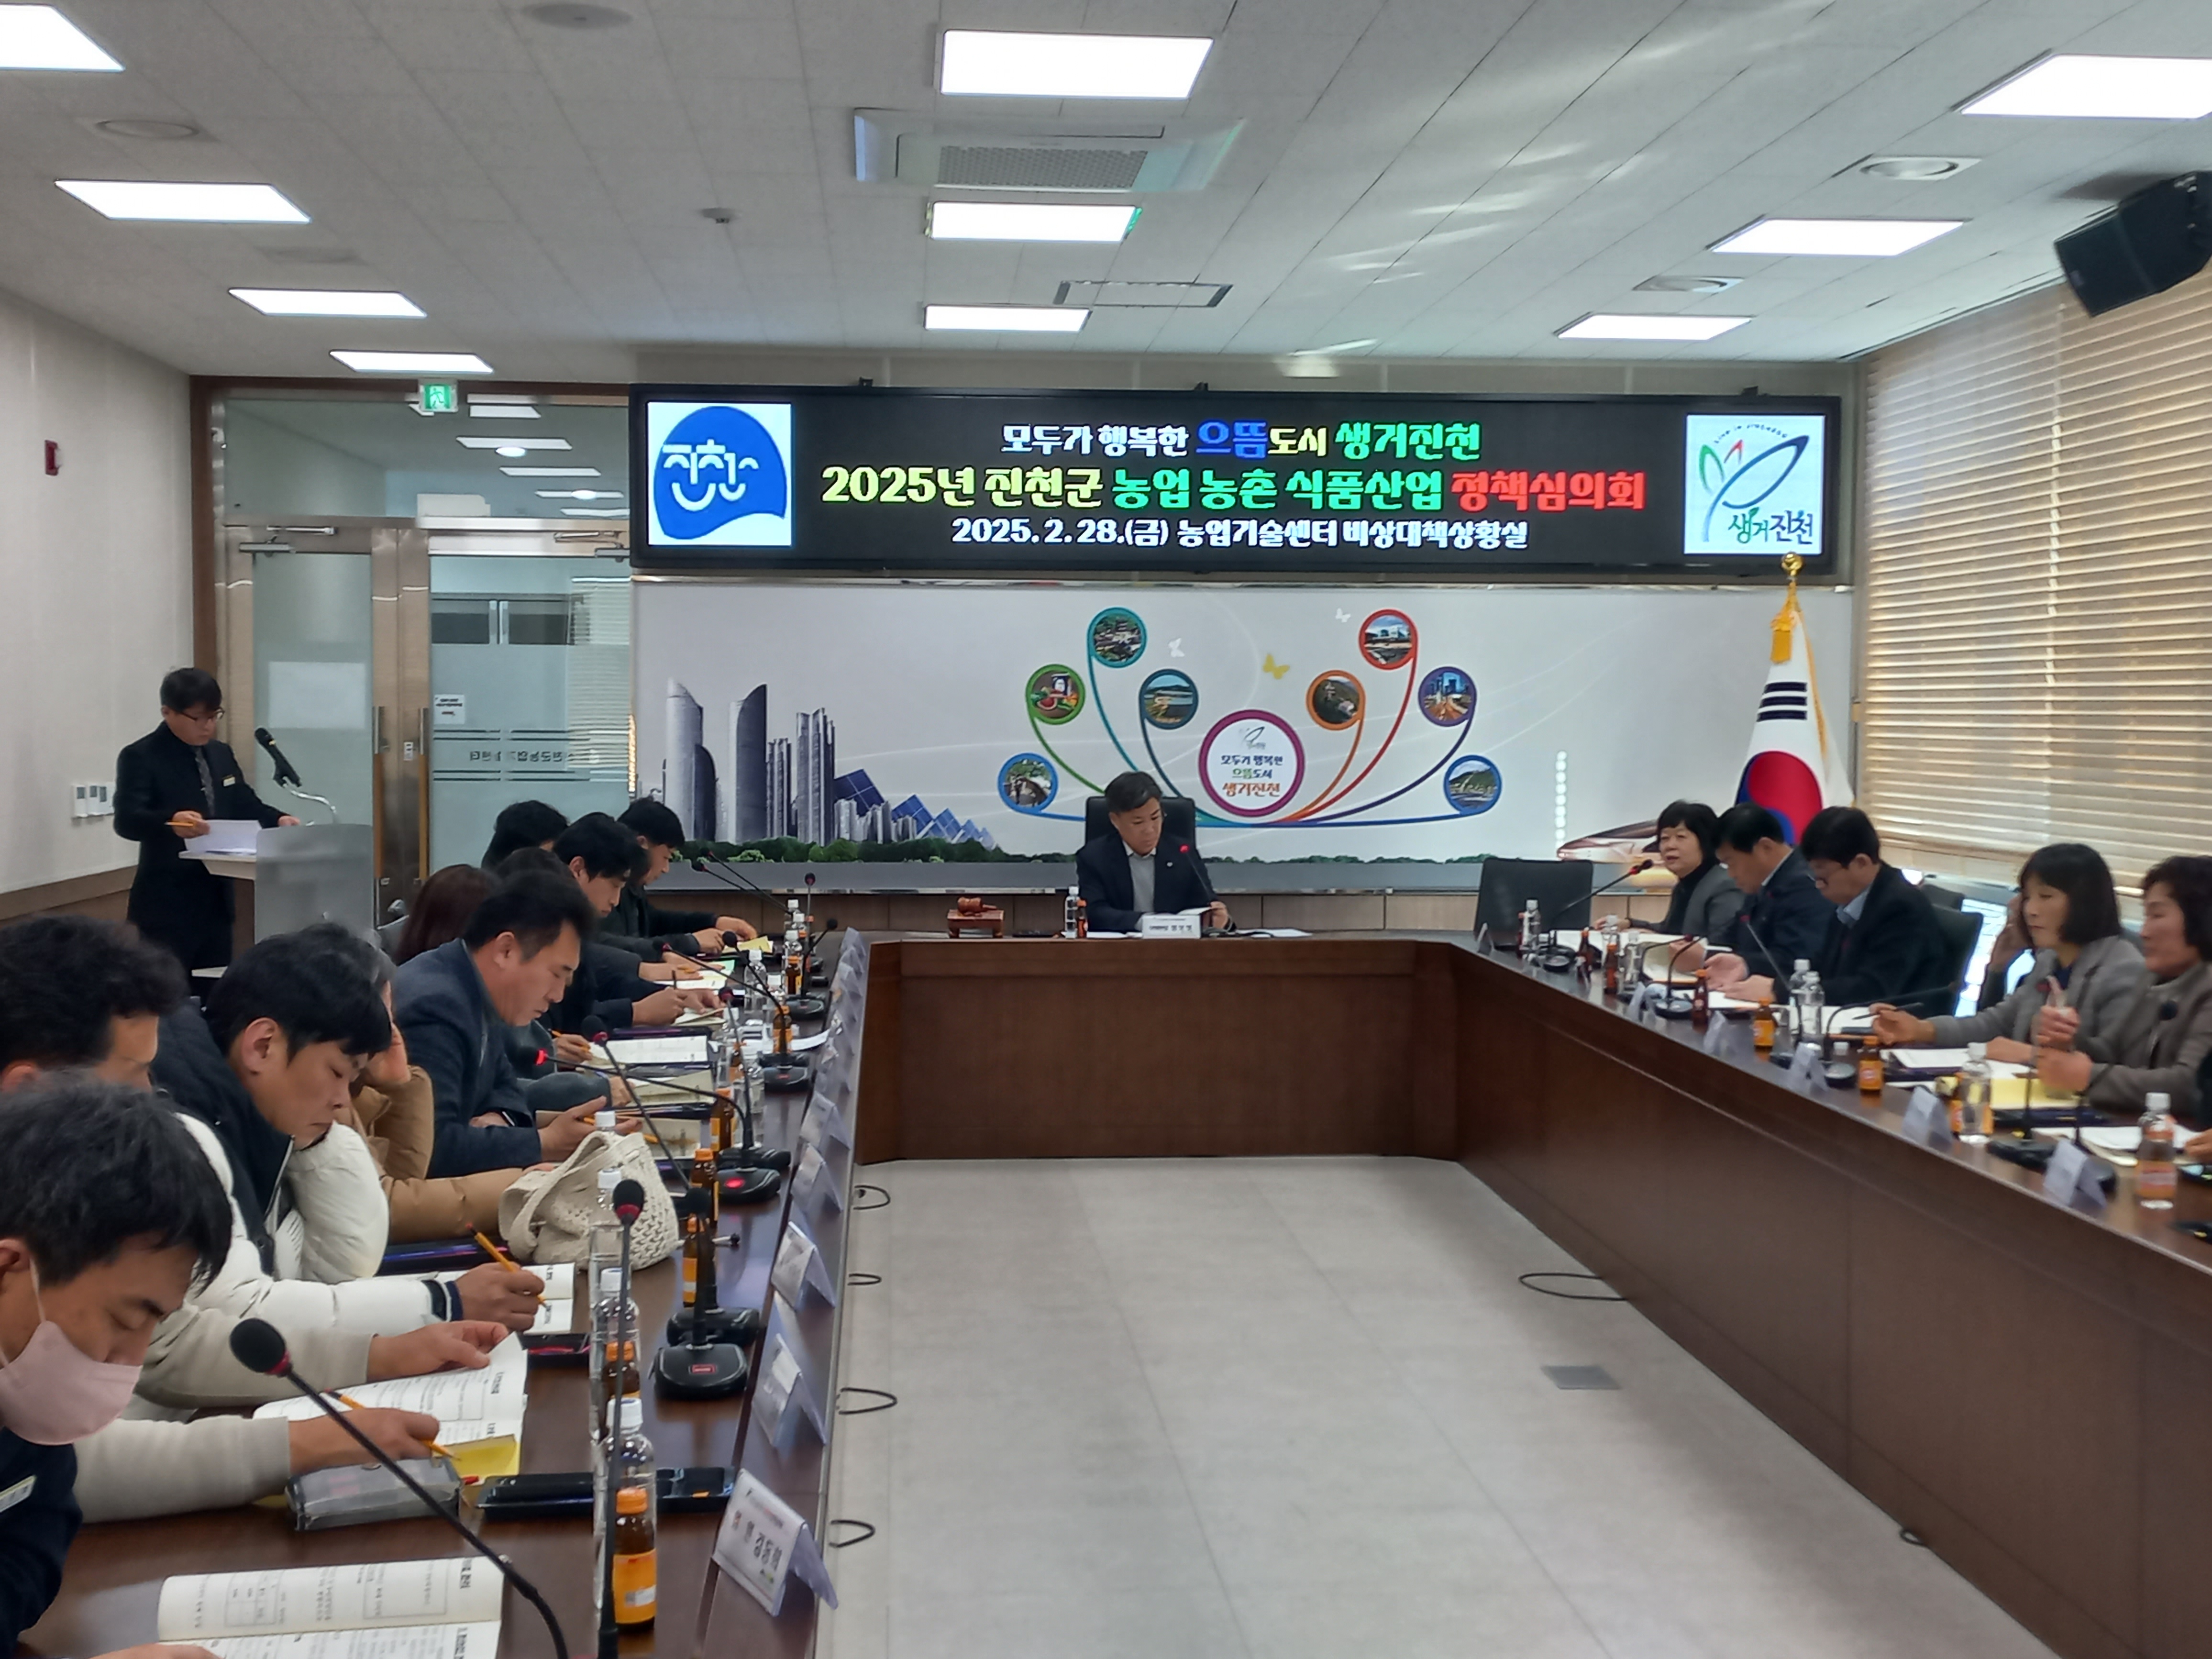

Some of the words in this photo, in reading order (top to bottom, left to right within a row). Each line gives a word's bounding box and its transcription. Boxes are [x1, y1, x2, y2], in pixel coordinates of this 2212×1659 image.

[1002, 424, 1093, 454] 모두가
[1097, 425, 1189, 457] 행복한
[1196, 421, 1327, 459] 으뜸도시
[1335, 422, 1480, 460] 생거진천
[822, 467, 974, 507] 2025년
[984, 467, 1103, 508] 진천군
[1112, 469, 1190, 509] 농업
[1199, 469, 1277, 509] 농촌
[1285, 470, 1442, 510] 식품산업
[1451, 471, 1645, 511] 정책심의회
[1177, 520, 1338, 547] 농업기술센터
[1342, 520, 1527, 549] 비상대책상황실
[1728, 507, 1813, 544] 생거진천
[1222, 782, 1281, 797] 생거진천
